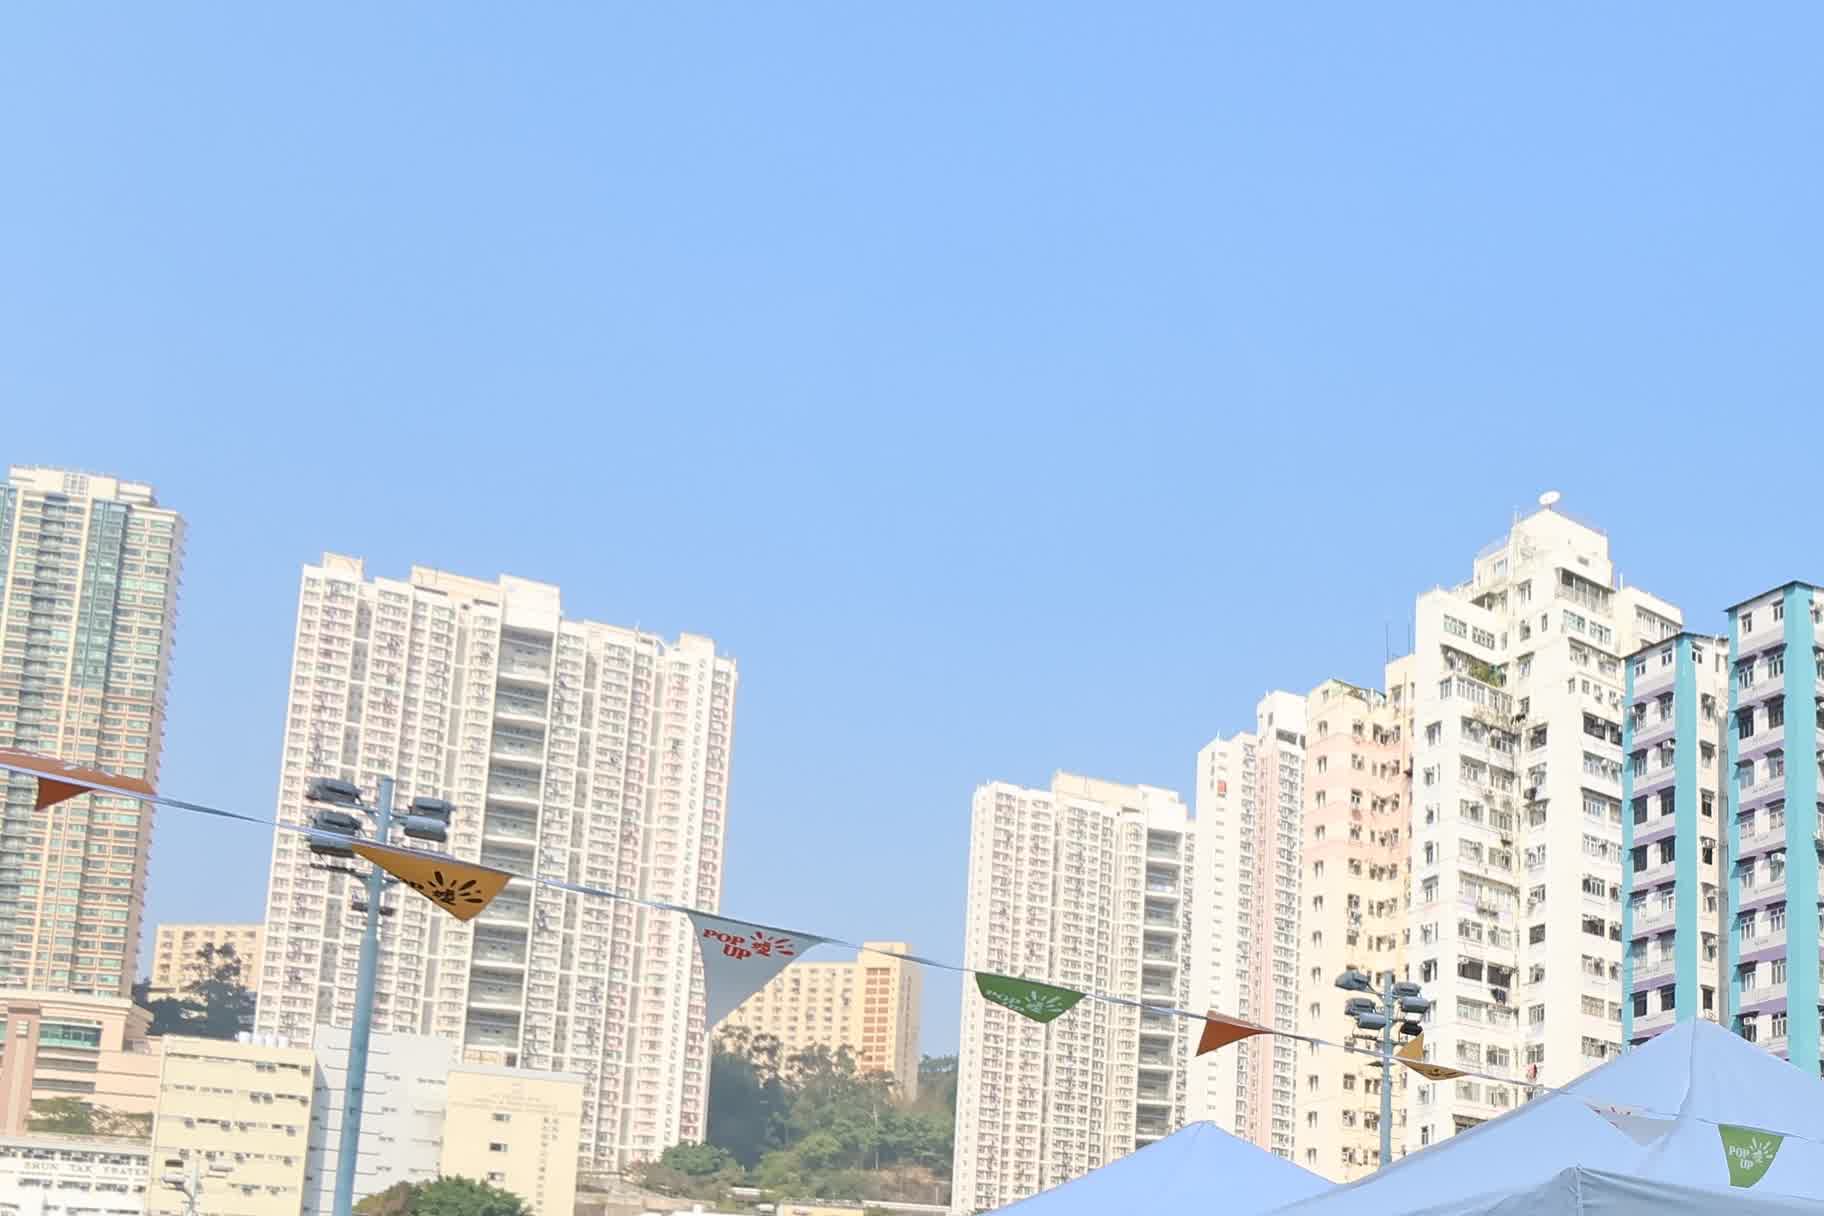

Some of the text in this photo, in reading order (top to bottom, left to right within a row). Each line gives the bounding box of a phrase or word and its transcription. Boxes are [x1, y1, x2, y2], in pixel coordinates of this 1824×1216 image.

[703, 929, 745, 945] POP
[723, 944, 752, 960] UP
[1728, 1144, 1750, 1159] POP
[1740, 1158, 1754, 1170] UP
